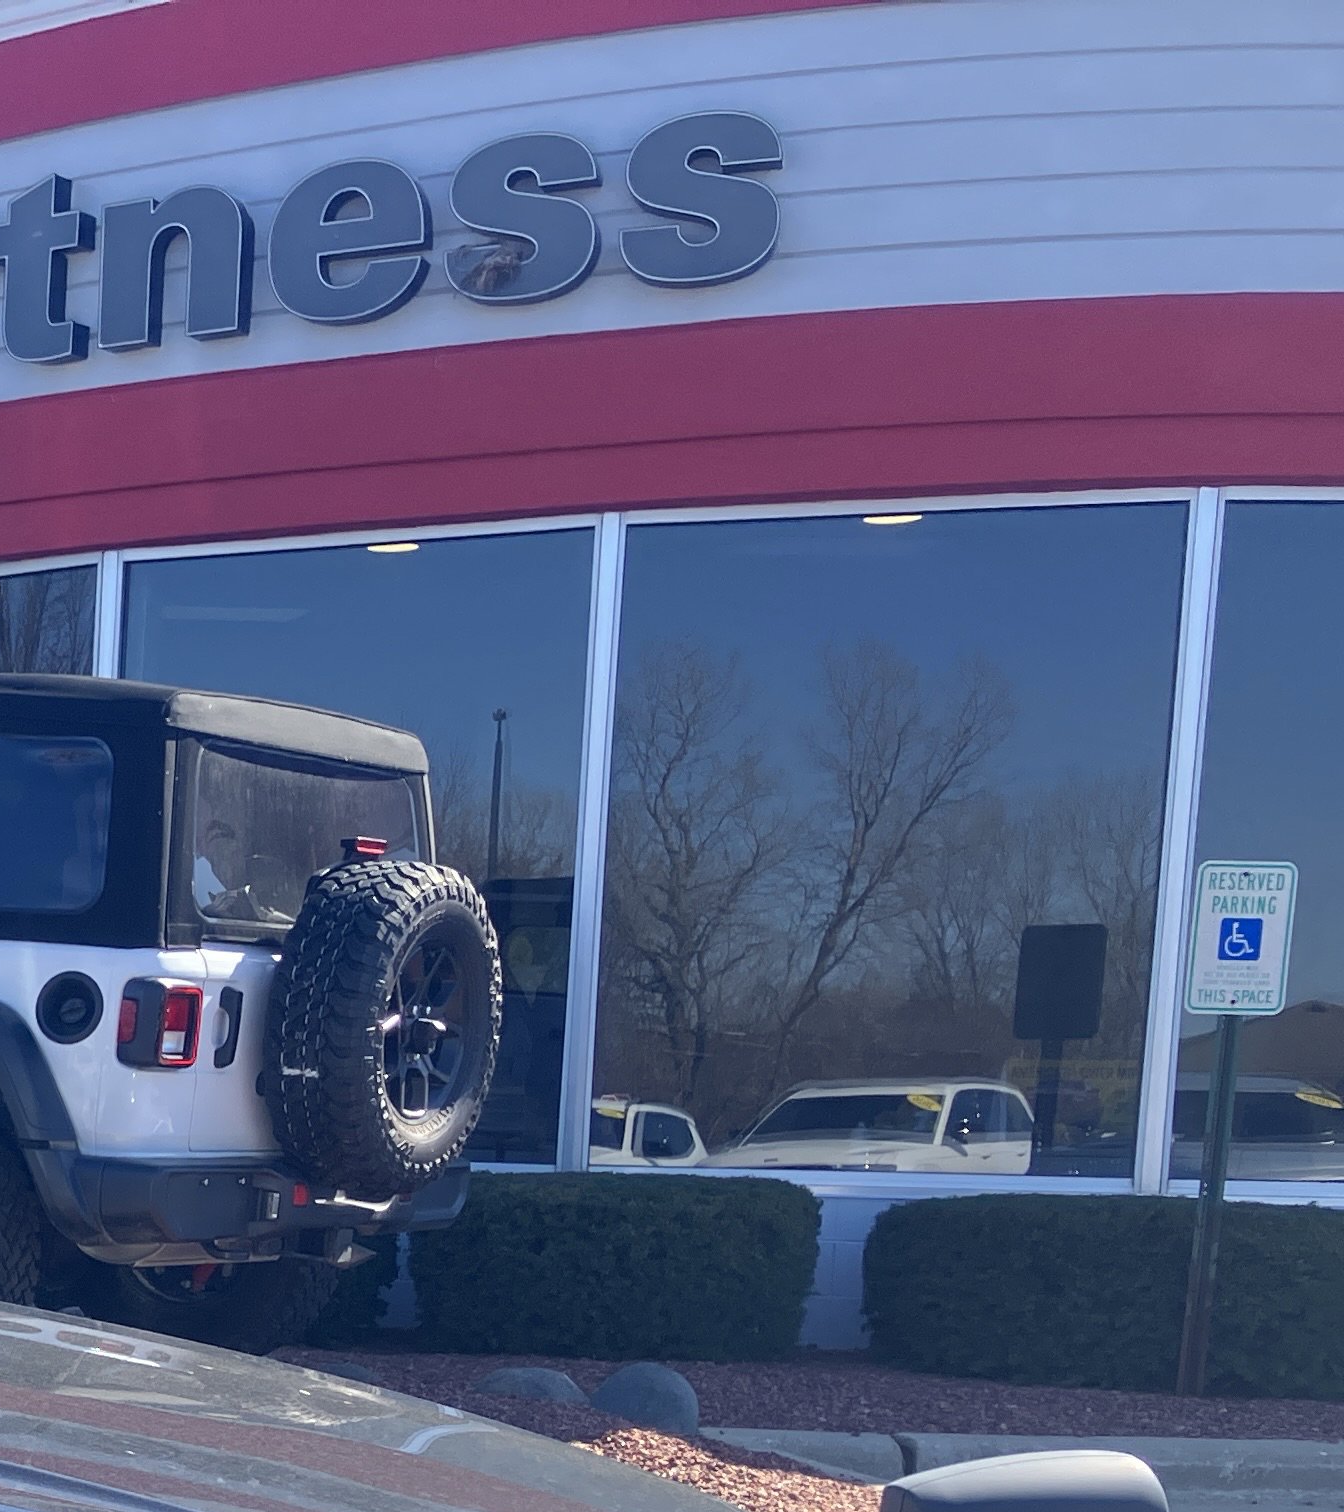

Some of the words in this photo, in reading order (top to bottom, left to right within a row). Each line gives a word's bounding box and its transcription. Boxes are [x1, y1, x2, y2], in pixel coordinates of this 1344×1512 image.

[1208, 872, 1285, 891] RESERVED
[1212, 896, 1278, 915] PARKING
[1197, 988, 1226, 1004] THIS
[1233, 989, 1274, 1004] SPACE
